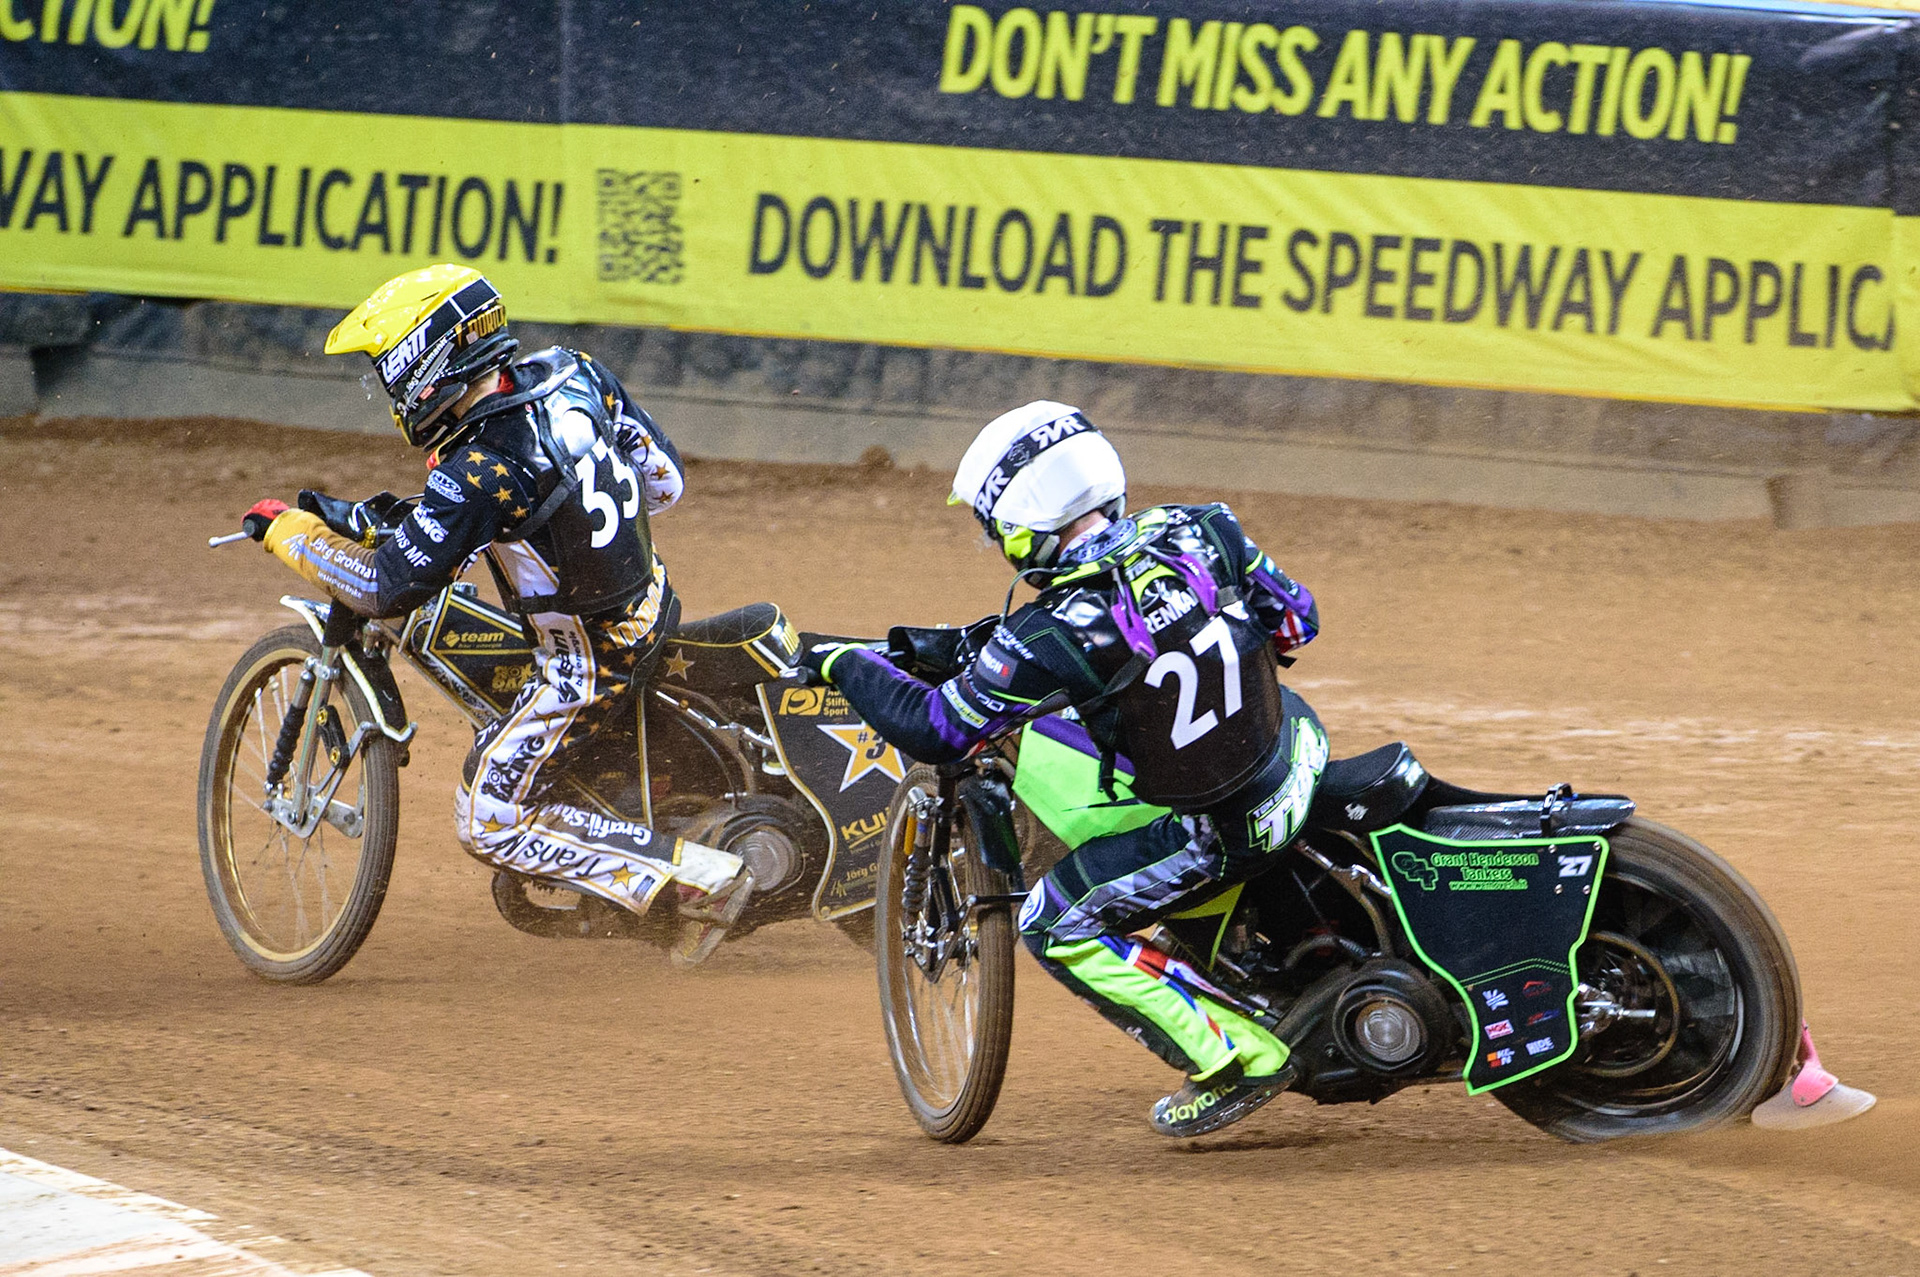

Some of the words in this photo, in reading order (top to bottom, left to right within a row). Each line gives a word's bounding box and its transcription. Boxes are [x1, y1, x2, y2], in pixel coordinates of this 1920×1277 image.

[939, 4, 1157, 105] DON'T
[1154, 18, 1320, 116] MISS
[1317, 29, 1477, 126] ANY
[1468, 39, 1752, 144] ACTION!
[121, 157, 565, 264] APPLICATION!
[747, 191, 1128, 299] DOWNLOAD
[1149, 217, 1270, 309] THE
[1280, 226, 1643, 336] SPEEDWAY
[1650, 253, 1896, 351] APPLIC
[574, 435, 641, 549] 33
[461, 632, 505, 642] team
[1143, 615, 1243, 750] 27
[823, 707, 849, 716] Sport
[1431, 852, 1468, 866] Grant
[1468, 851, 1540, 866] Henderson
[1460, 867, 1514, 881] Tankers
